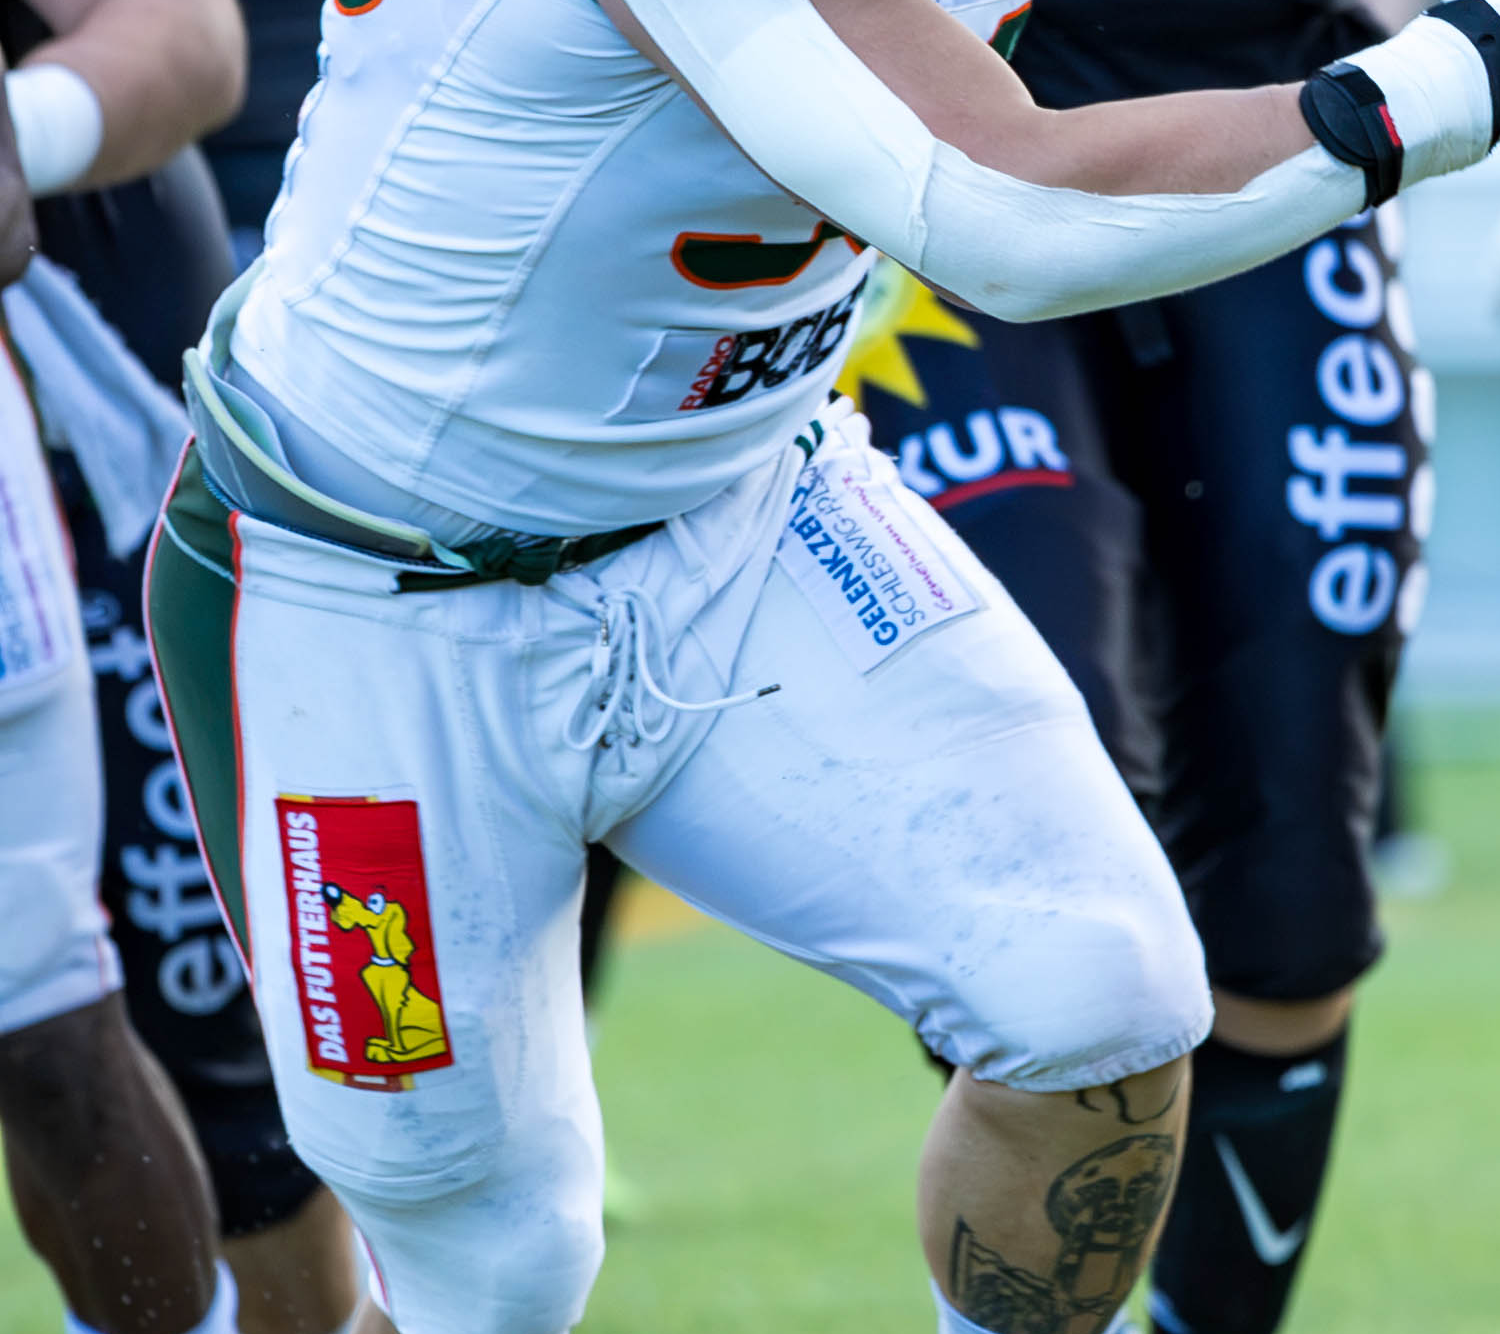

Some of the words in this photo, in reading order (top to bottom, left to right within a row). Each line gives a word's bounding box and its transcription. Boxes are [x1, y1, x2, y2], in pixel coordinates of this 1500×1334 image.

[677, 334, 736, 411] RADIO
[1287, 203, 1408, 636] effec
[286, 810, 338, 1004] FUTTERHAUS
[310, 1003, 350, 1064] DAS
